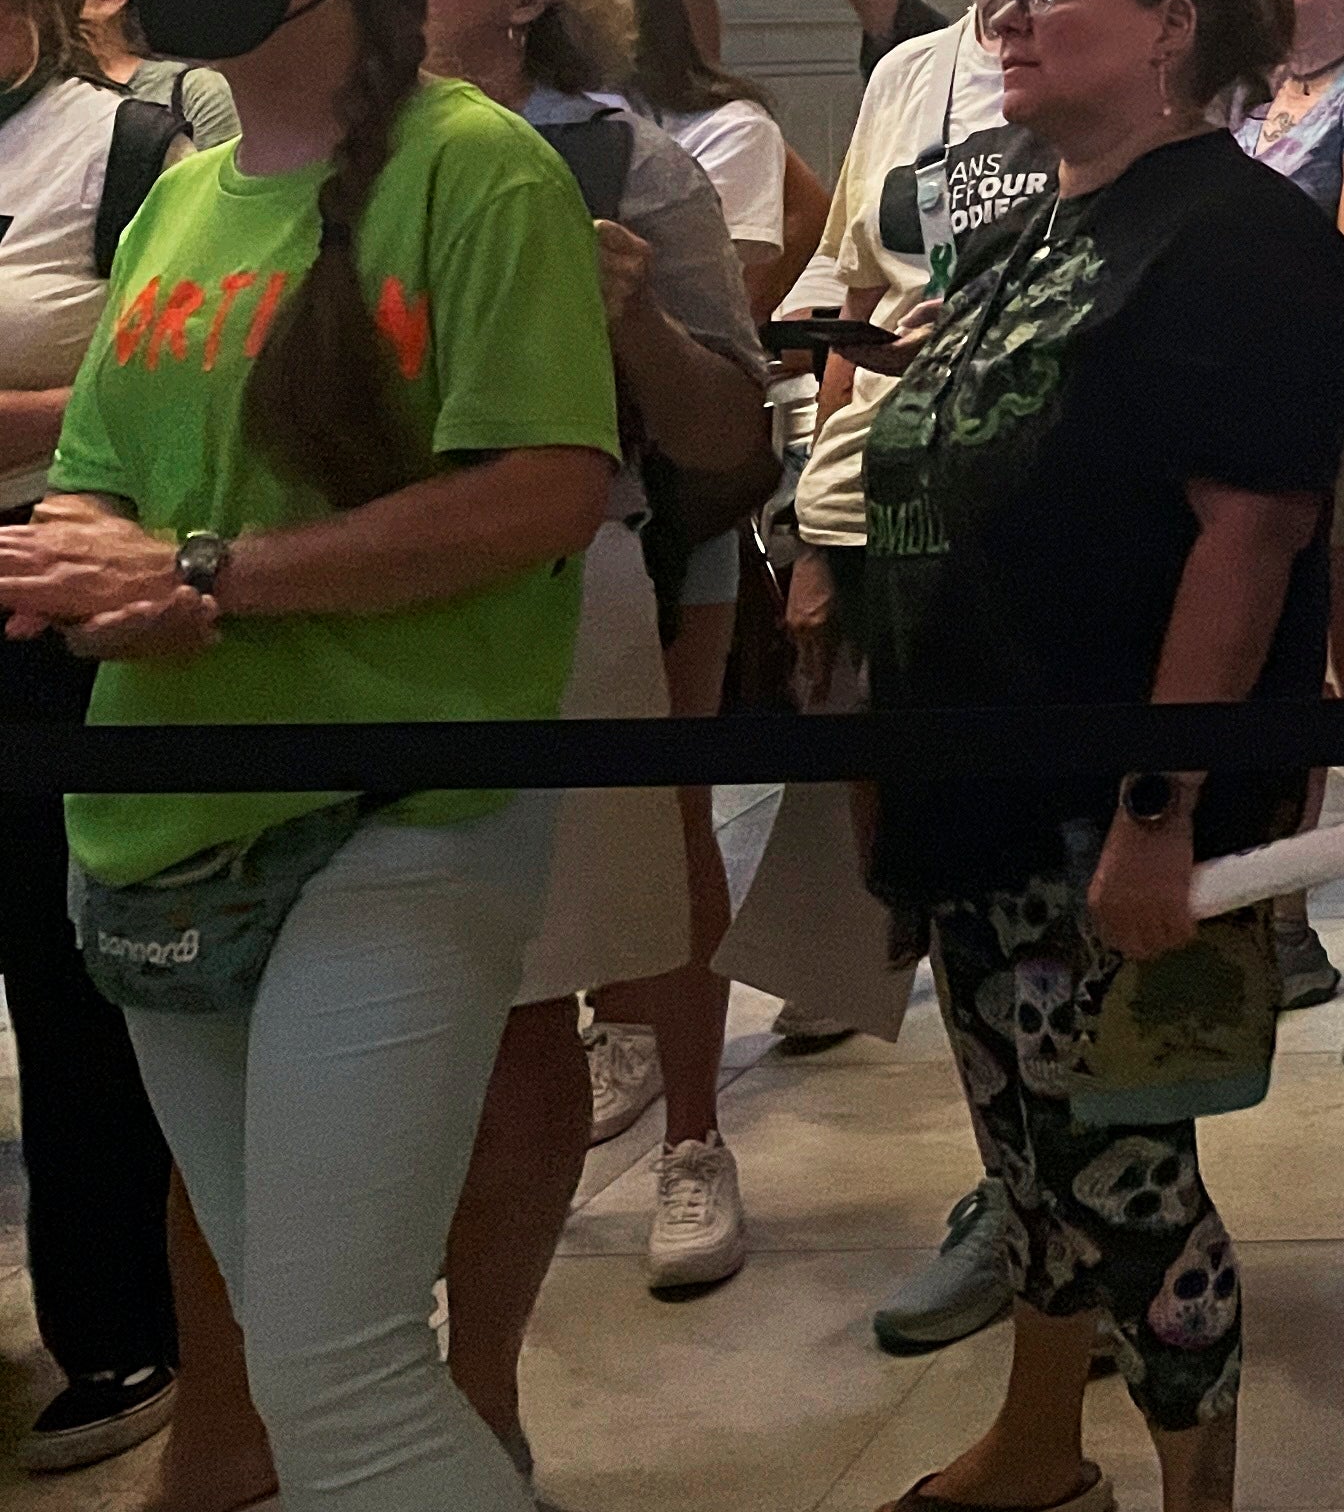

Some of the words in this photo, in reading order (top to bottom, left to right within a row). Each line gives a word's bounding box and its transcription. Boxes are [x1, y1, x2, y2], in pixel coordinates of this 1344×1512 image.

[949, 153, 1003, 185] ANS
[952, 179, 976, 209] FF
[978, 173, 1047, 199] OUR
